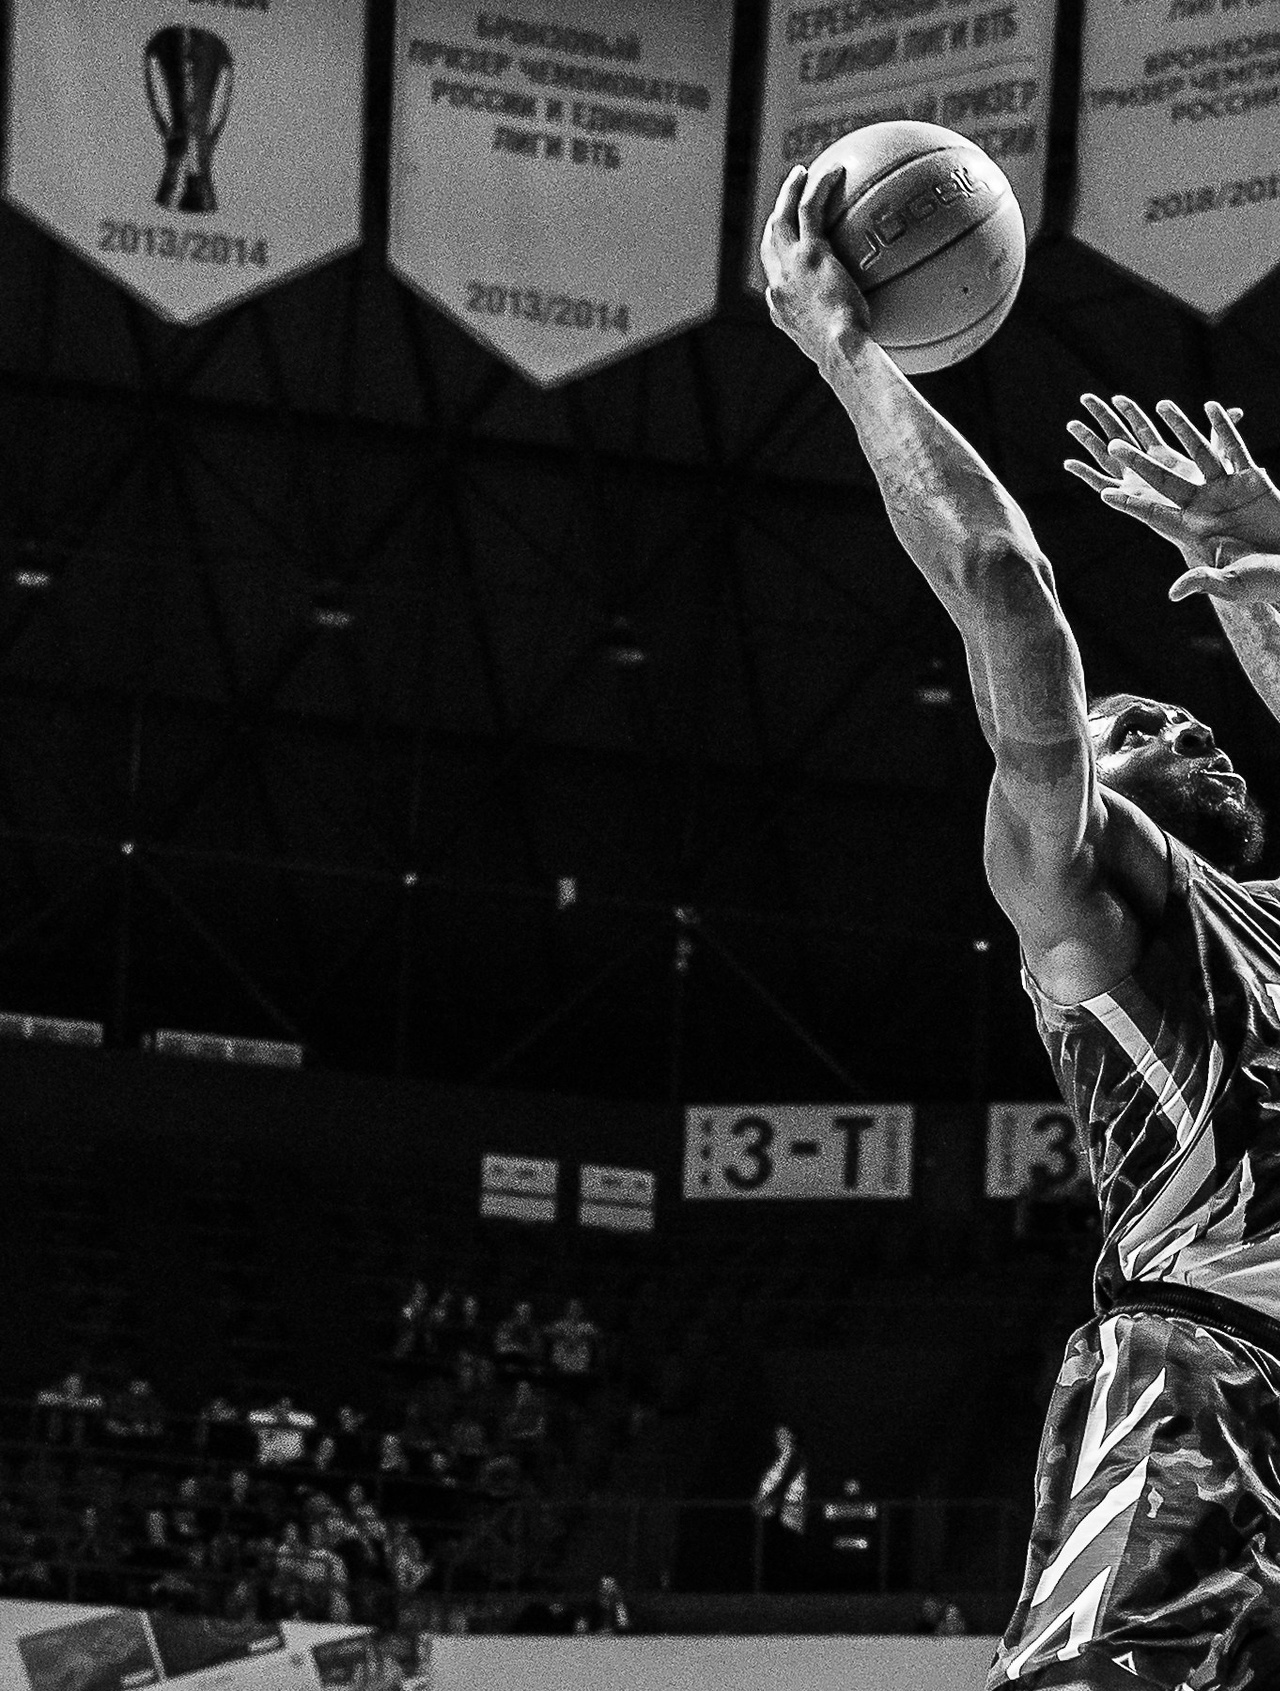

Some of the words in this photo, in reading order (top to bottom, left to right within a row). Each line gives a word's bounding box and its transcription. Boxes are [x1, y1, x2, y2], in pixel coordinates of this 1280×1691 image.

[1171, 84, 1280, 124] РОССИИ
[99, 217, 269, 268] 2013/2014
[466, 279, 632, 333] 2013/2014
